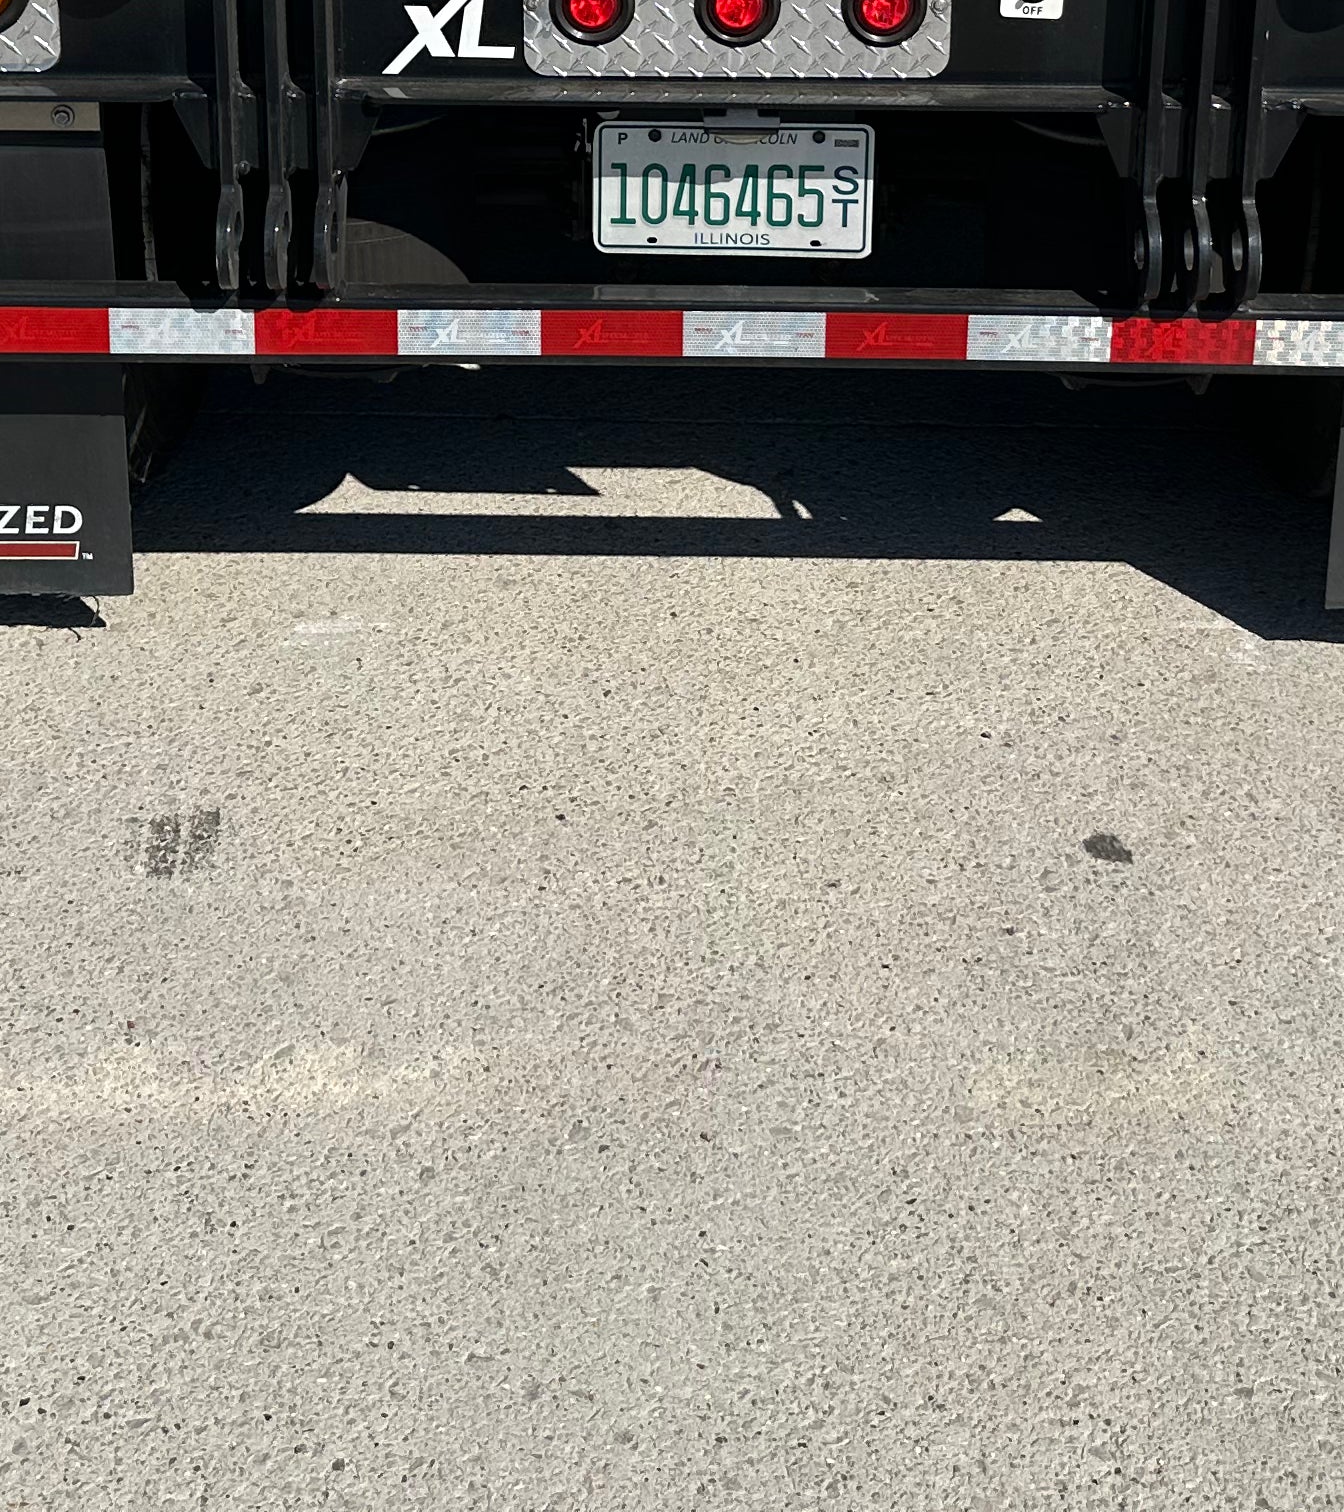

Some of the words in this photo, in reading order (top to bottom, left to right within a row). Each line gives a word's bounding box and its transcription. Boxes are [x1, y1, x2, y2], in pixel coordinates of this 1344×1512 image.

[1022, 5, 1044, 16] OFF
[617, 132, 628, 145] P
[671, 131, 710, 144] LAND
[610, 162, 826, 228] 1046465
[694, 232, 771, 246] ILLINOIS
